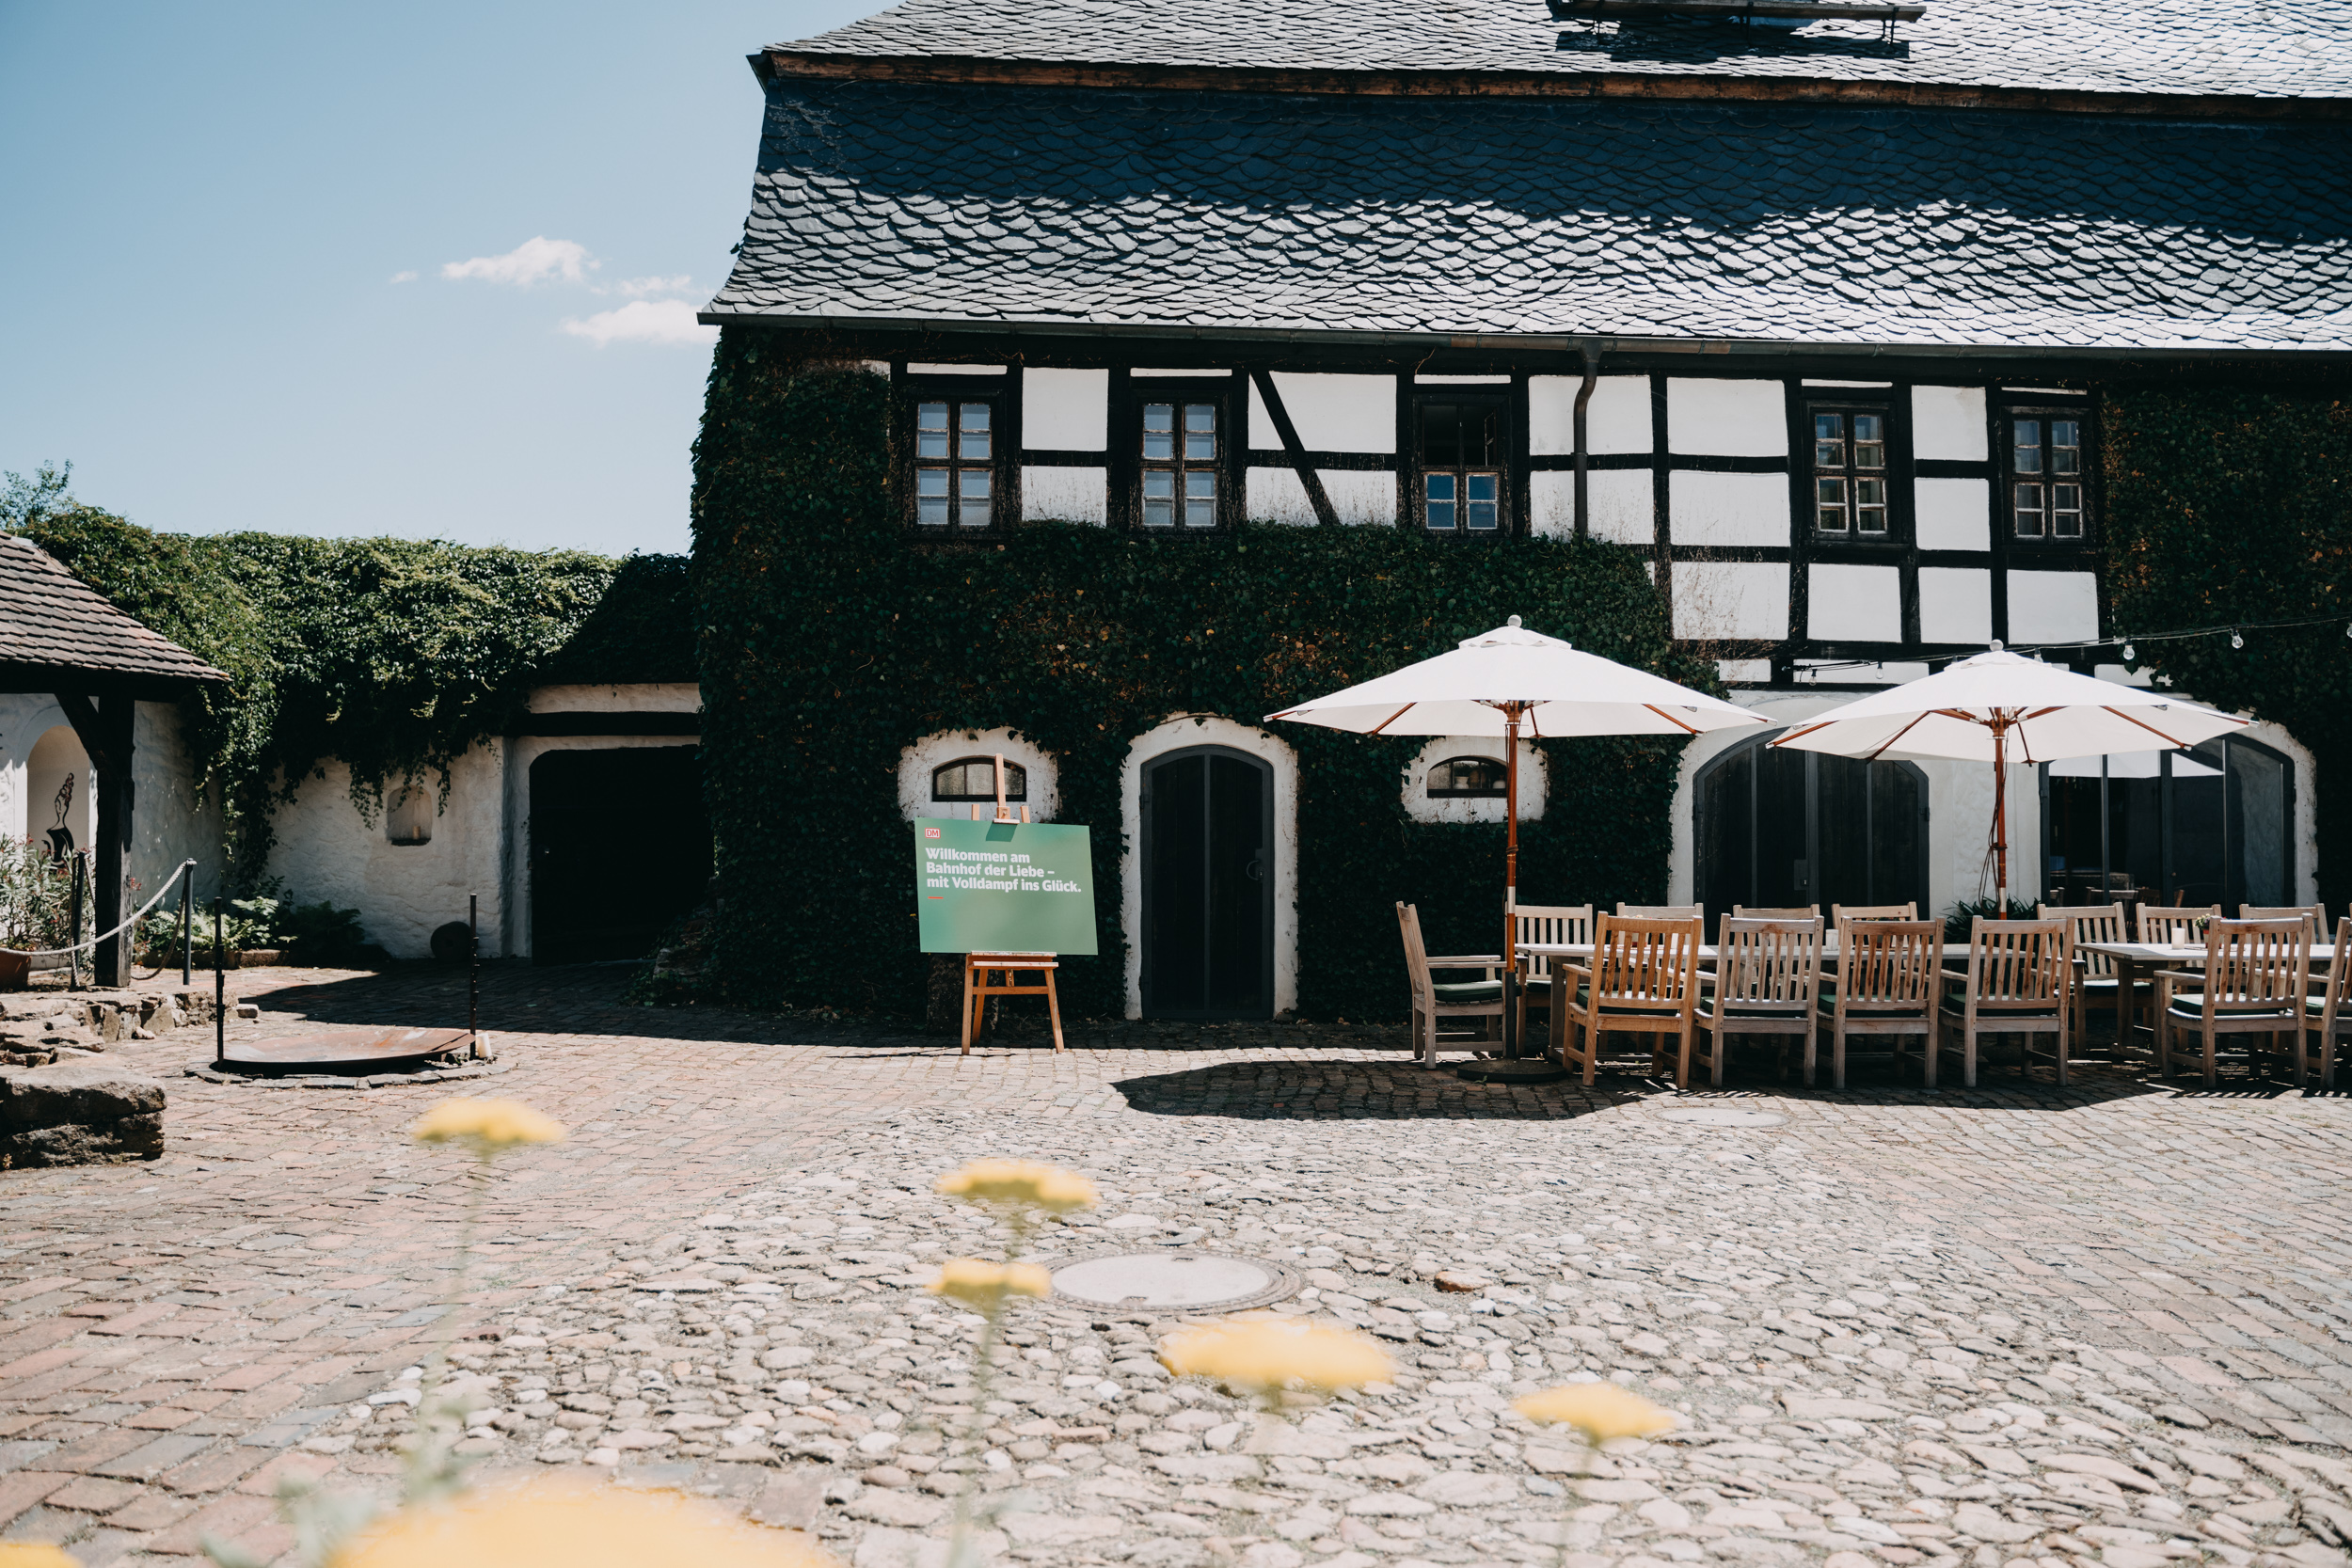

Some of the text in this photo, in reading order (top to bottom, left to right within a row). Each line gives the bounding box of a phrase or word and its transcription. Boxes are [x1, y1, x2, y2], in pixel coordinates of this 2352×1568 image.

[926, 829, 940, 838] DM
[925, 847, 1030, 863] Willkommen am
[927, 863, 981, 875] Bahnhof
[984, 864, 1007, 876] der
[1009, 865, 1044, 878] Liebe
[927, 877, 1081, 893] mit Volldampf ins Glück.
